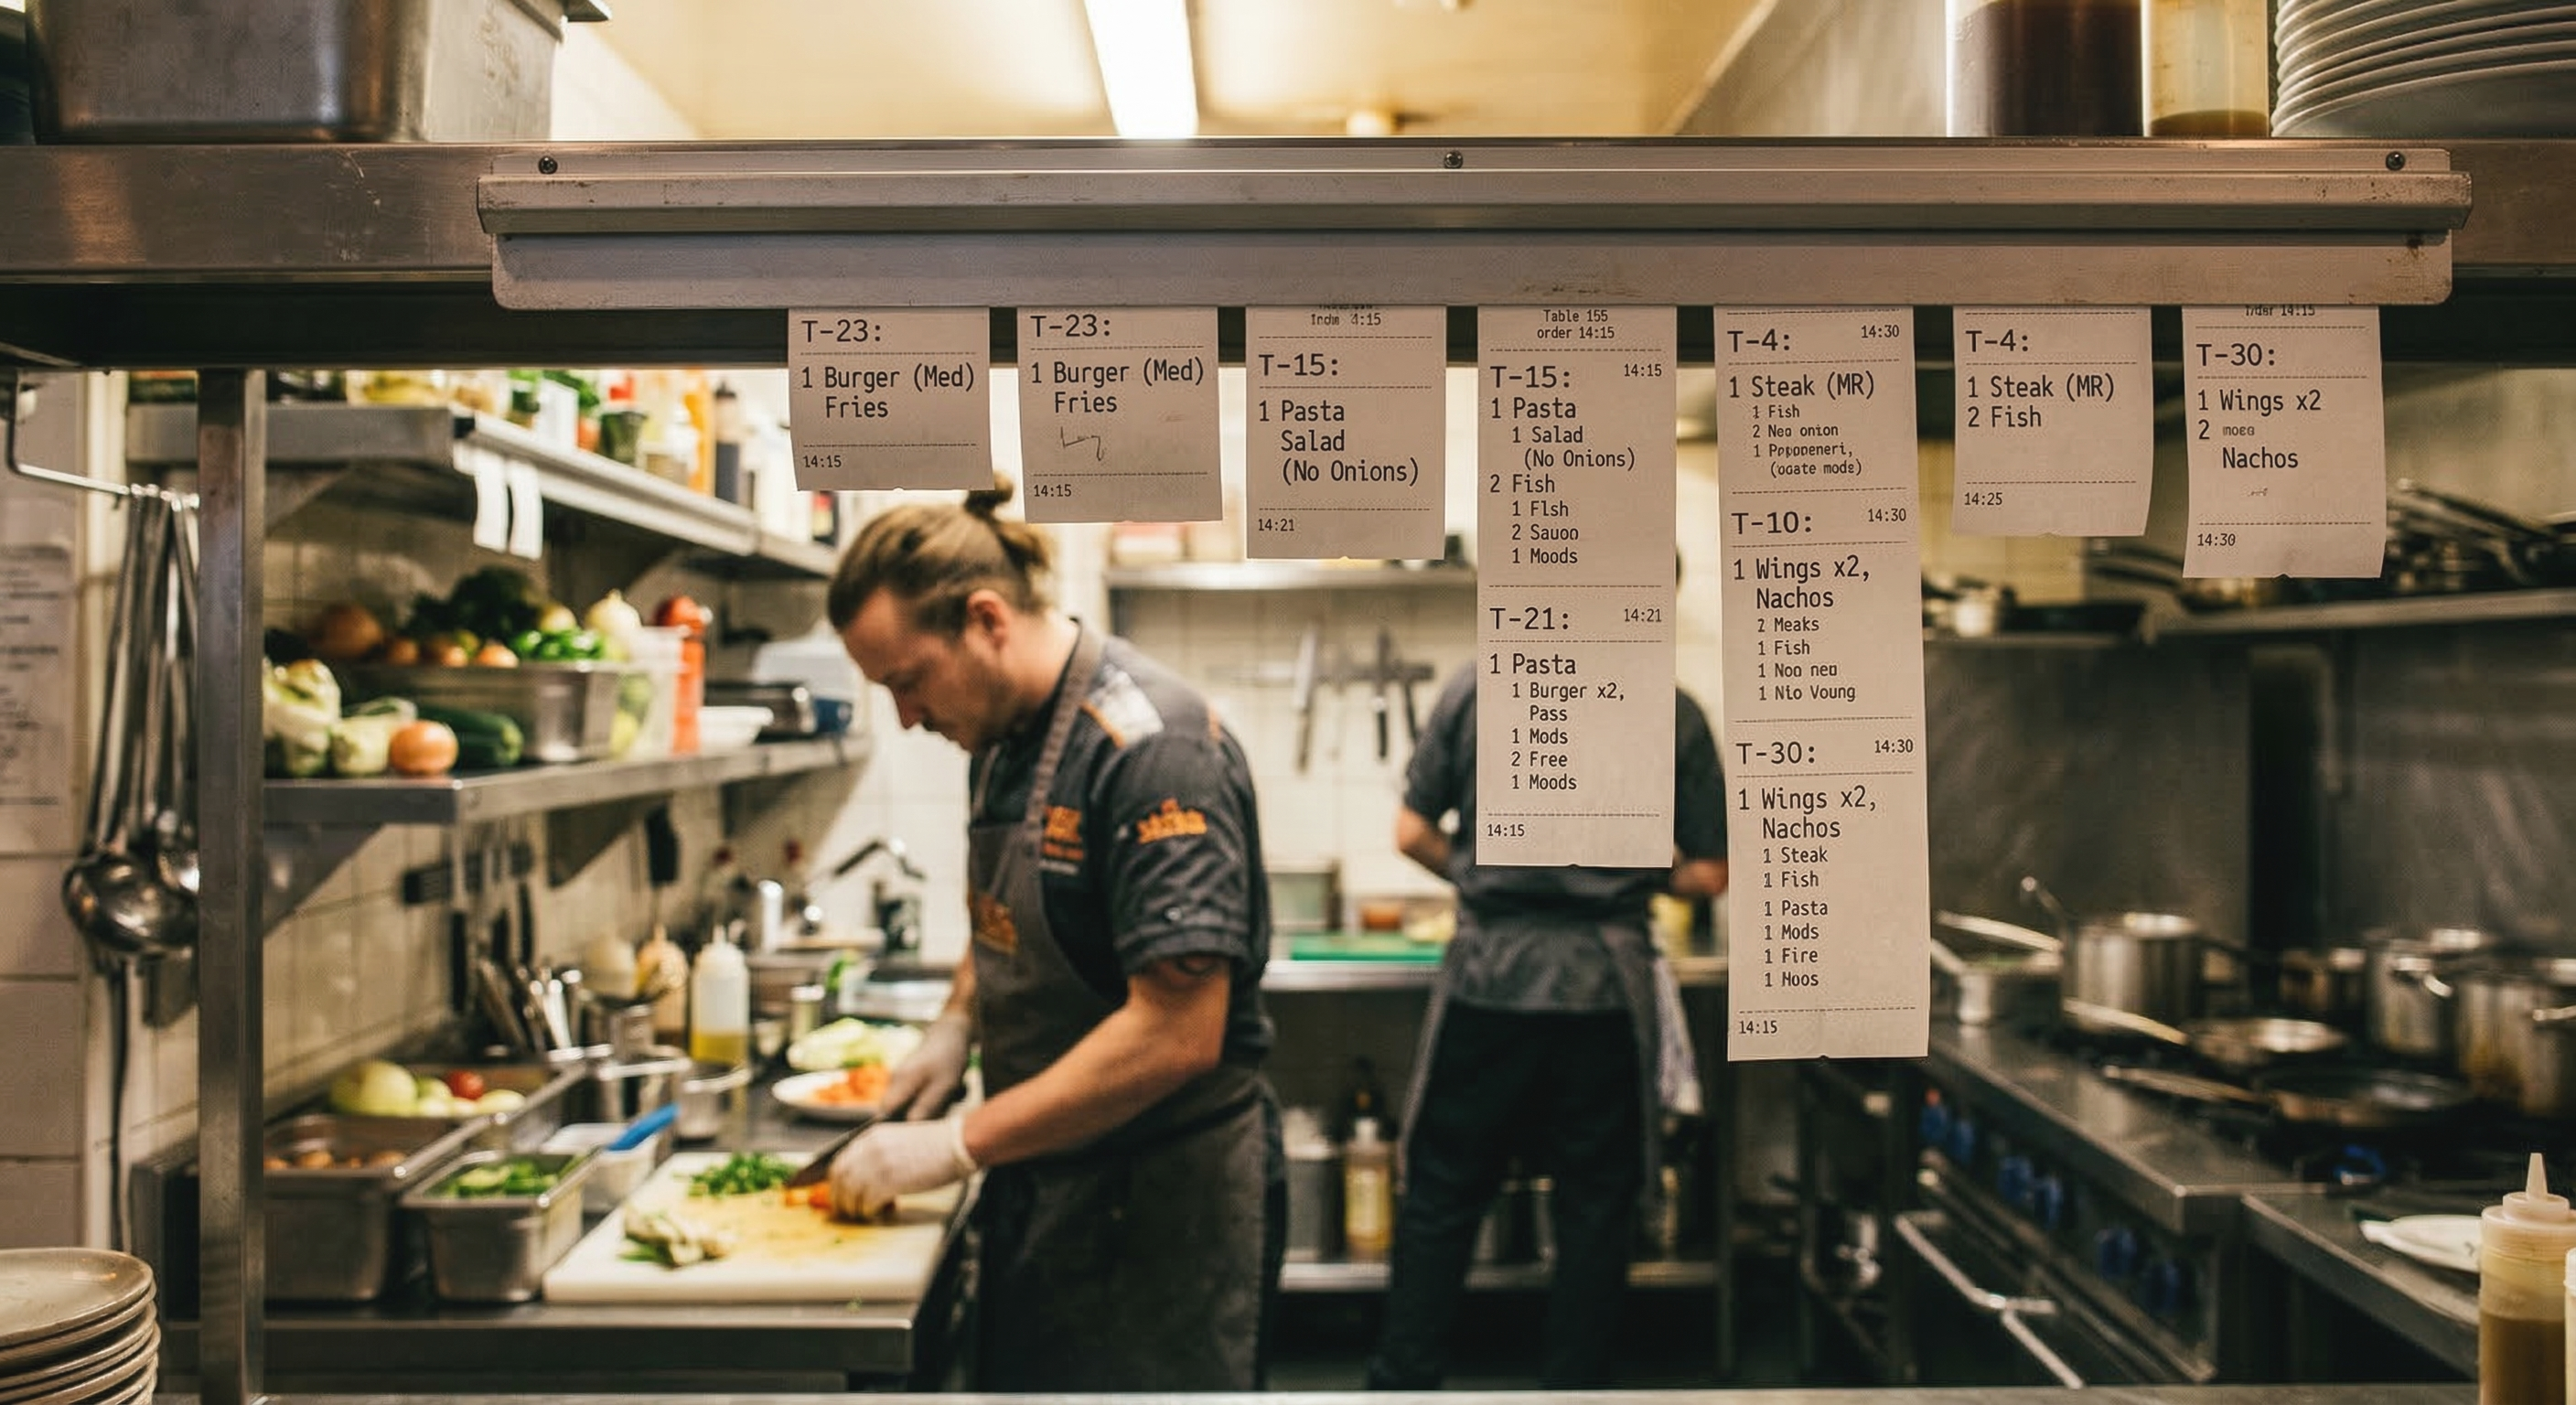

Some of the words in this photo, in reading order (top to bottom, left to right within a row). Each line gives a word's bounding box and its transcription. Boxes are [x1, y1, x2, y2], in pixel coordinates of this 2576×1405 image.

[1029, 313, 1111, 338] T-23:
[1542, 308, 1580, 323] Table
[1586, 308, 1608, 323] 155
[800, 318, 881, 343] T-23:
[1537, 325, 1572, 339] order
[1579, 326, 1615, 339] 14:15
[1726, 328, 1790, 353] T-4:
[1861, 324, 1900, 338] 14:30
[1965, 328, 2029, 353] T-4:
[1258, 352, 1338, 377] T-15:
[2195, 342, 2275, 367] T-30:
[801, 366, 813, 389] 1
[824, 366, 901, 394] Burger
[913, 361, 974, 392] (Med)
[1031, 361, 1043, 384] 1
[1053, 360, 1130, 389] Burger
[1143, 356, 1204, 387] (Med)
[1489, 365, 1570, 389] T-15:
[1624, 363, 1662, 377] 14:15
[1729, 375, 1740, 399] 1
[1751, 373, 1816, 398] Steak
[1827, 370, 1874, 401] (MR)
[1968, 375, 1979, 398] 1
[1991, 374, 2055, 398] Steak
[2066, 372, 2114, 402] (MR)
[825, 394, 889, 419] Fries
[1055, 390, 1118, 413] Fries
[1259, 400, 1270, 422] 1
[1282, 399, 1345, 422] Pasta
[1491, 397, 1502, 419] 1
[1513, 396, 1576, 419] Pasta
[1752, 404, 1760, 420] 1
[1768, 403, 1800, 419] Fish
[2197, 389, 2209, 411] 1
[2219, 388, 2284, 417] Wings
[2295, 389, 2322, 411] x2
[1967, 405, 1980, 428] 2
[1991, 404, 2042, 428] Fish
[1512, 425, 1521, 444] 1
[1531, 424, 1583, 444] Salad
[1752, 424, 1761, 438] 2
[1799, 425, 1839, 437] onion
[2198, 419, 2210, 440] 2
[1281, 428, 1345, 452] Salad
[1524, 447, 1554, 471] (No
[1562, 446, 1635, 472] Onions)
[1753, 444, 1761, 458] 1
[2222, 445, 2299, 469] Nachos
[802, 455, 842, 468] 14:15
[1283, 457, 1320, 487] (No
[1330, 456, 1419, 488] Onions)
[1034, 483, 1072, 498] 14:15
[1489, 473, 1500, 493] 2
[1512, 473, 1555, 493] Fish
[1512, 499, 1521, 517] 1
[1964, 491, 2003, 506] 14:25
[1258, 518, 1295, 532] 14:21
[1731, 510, 1811, 535] T-10:
[1867, 508, 1907, 522] 14:30
[1511, 523, 1521, 541] 2
[2197, 532, 2237, 547] 14:30
[1512, 547, 1520, 564] 1
[1530, 546, 1578, 564] Moods
[1733, 558, 1745, 581] 1
[1755, 556, 1821, 585] Wings
[1833, 554, 1870, 583] x2,
[1756, 585, 1834, 609] Nachos
[1489, 606, 1569, 630] T-21:
[1624, 607, 1662, 623] 14:21
[1757, 617, 1766, 633] 2
[1774, 616, 1819, 633] Meaks
[1757, 640, 1766, 656] 1
[1774, 638, 1810, 656] Fish
[1489, 652, 1501, 674] 1
[1512, 652, 1576, 675] Pasta
[1758, 662, 1766, 679] 1
[1512, 681, 1520, 699] 1
[1530, 681, 1588, 702] Burger
[1596, 681, 1625, 702] x2,
[1758, 685, 1767, 702] 1
[1530, 704, 1568, 722] Pass
[1511, 727, 1520, 745] 1
[1530, 727, 1569, 745] Mods
[1511, 750, 1521, 767] 2
[1530, 750, 1568, 767] Free
[1735, 741, 1815, 766] T-30:
[1874, 738, 1914, 754] 14:30
[1511, 774, 1520, 789] 1
[1529, 772, 1577, 790] Moods
[1738, 788, 1750, 810] 1
[1761, 787, 1828, 815] Wings
[1840, 784, 1876, 812] x2,
[1487, 823, 1525, 837] 14:15
[1762, 815, 1841, 840] Nachos
[1763, 847, 1772, 864] 1
[1781, 845, 1829, 864] Steak
[1764, 872, 1773, 888] 1
[1781, 870, 1819, 888] Fish
[1764, 900, 1773, 917] 1
[1781, 899, 1829, 917] Pasta
[1764, 924, 1773, 941] 1
[1781, 922, 1819, 940] Mods
[1764, 948, 1773, 964] 1
[1781, 946, 1819, 964] Fire
[1765, 971, 1773, 988] 1
[1739, 1020, 1778, 1035] 14:15
